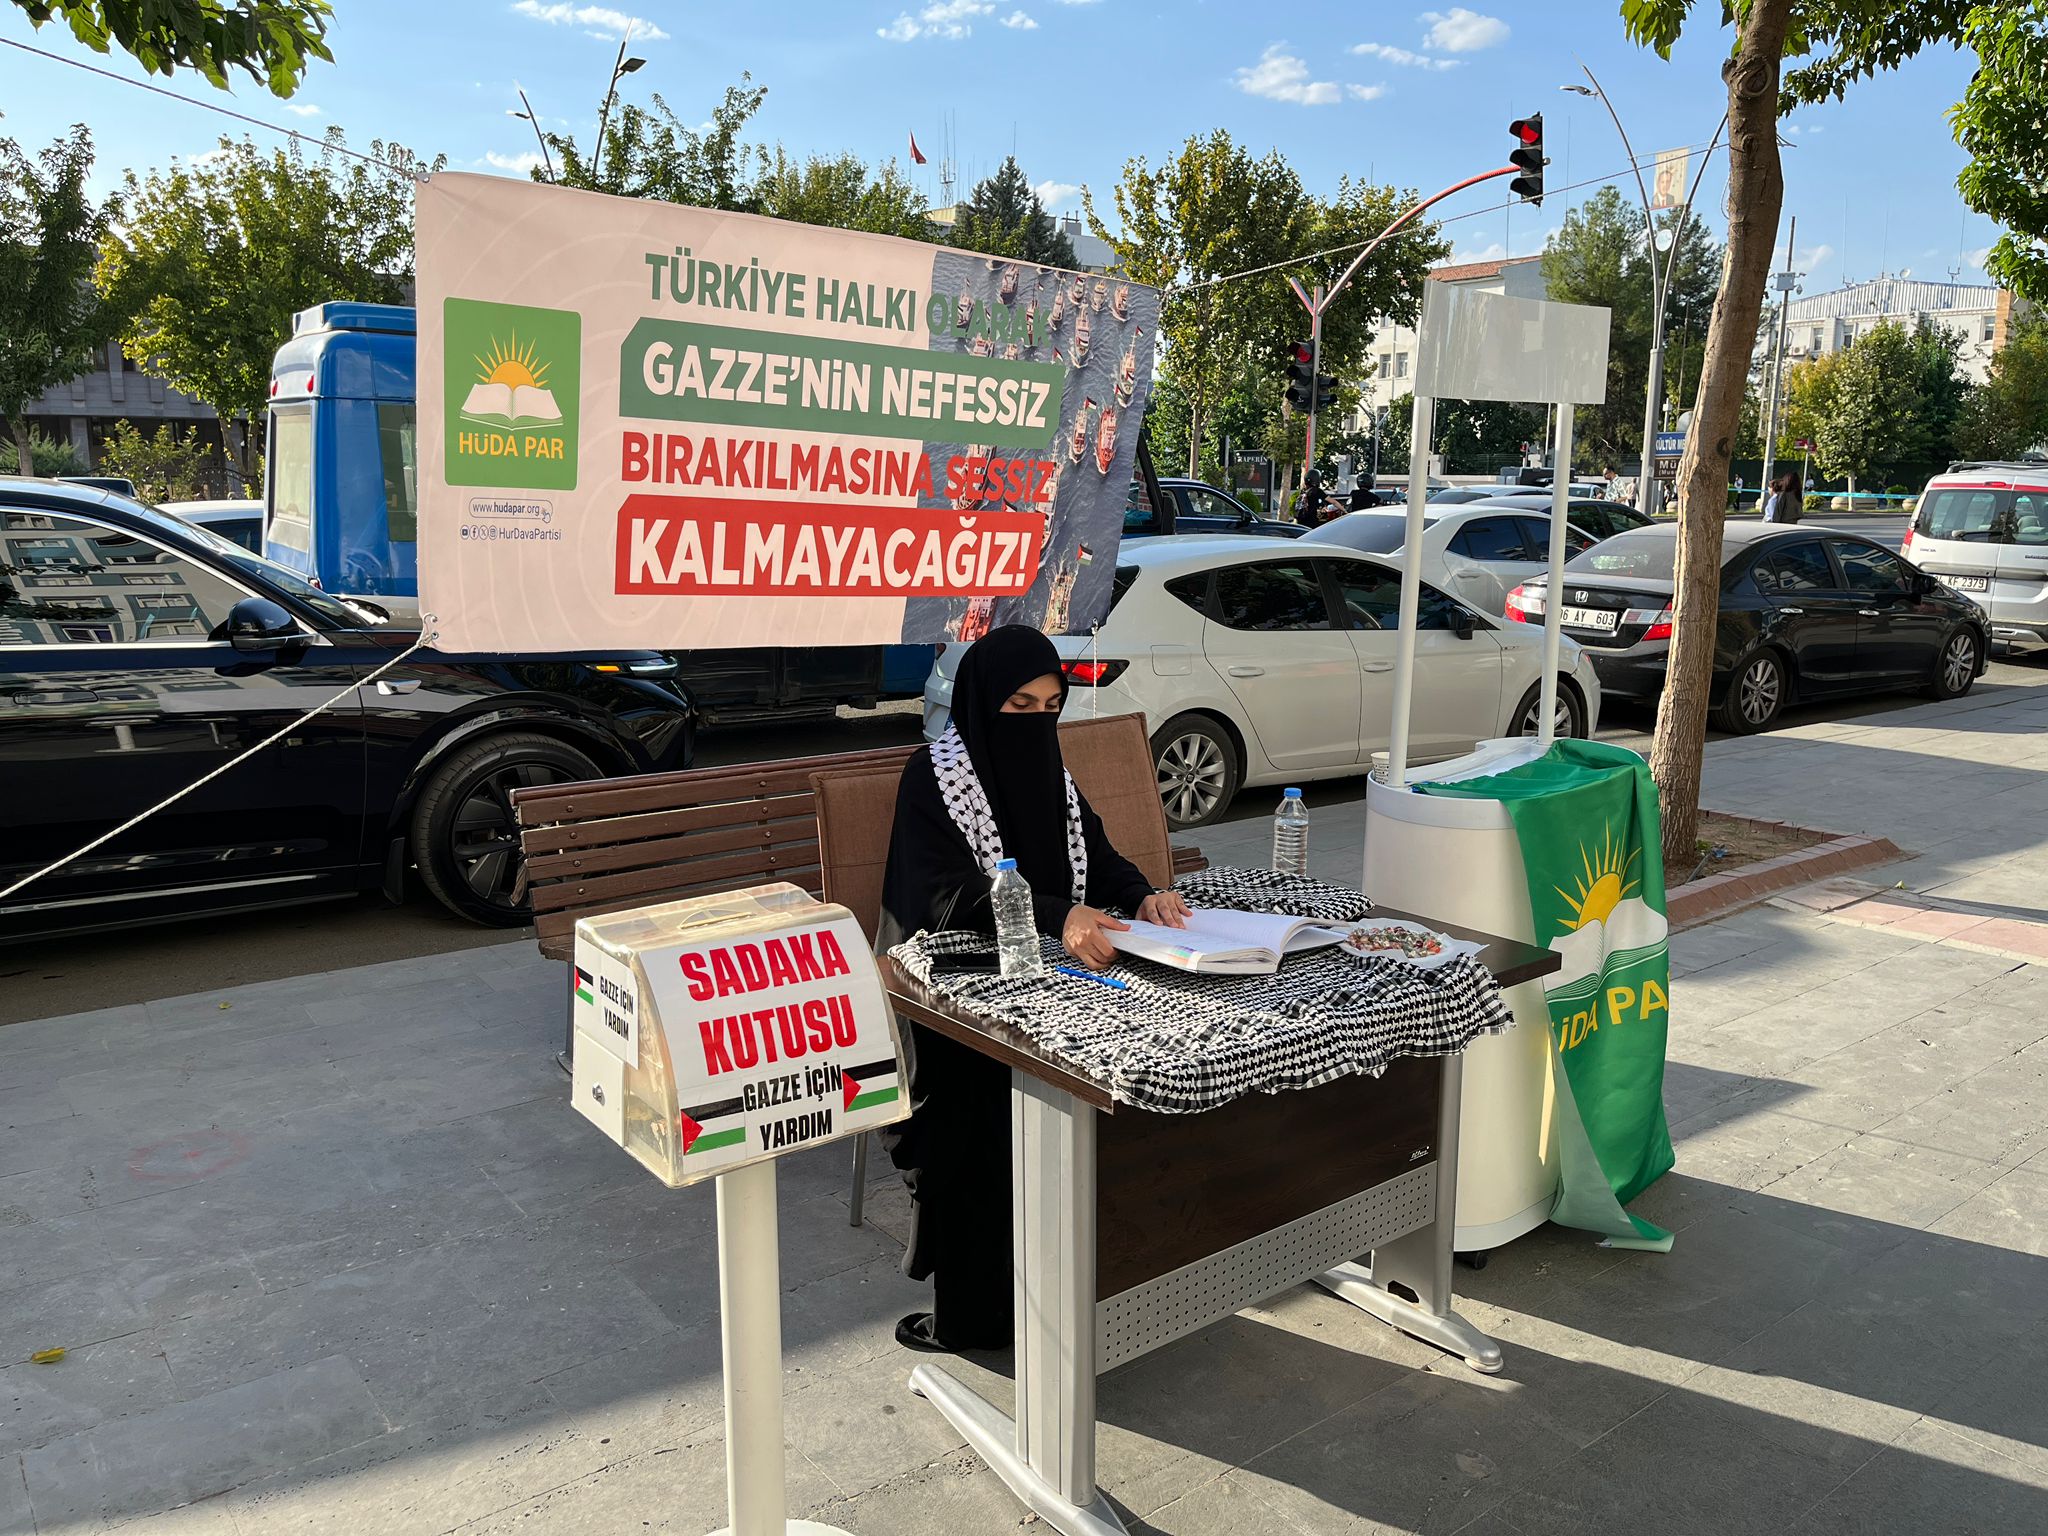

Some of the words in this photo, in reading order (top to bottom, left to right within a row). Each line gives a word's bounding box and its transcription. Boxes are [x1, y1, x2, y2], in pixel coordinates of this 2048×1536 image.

[645, 246, 806, 318] TÜRKİYE
[816, 276, 917, 332] HALKI
[926, 293, 1051, 347] OLARAK
[460, 432, 519, 456] HÜDA
[525, 436, 564, 459] PAR
[1660, 460, 1677, 469] Mü
[622, 432, 934, 499] BIRAKILMASINA
[472, 502, 540, 516] www.hudapar.org
[499, 527, 562, 540] HurDavaPartisi
[629, 515, 1032, 588] KALMAYACAĞIZ!
[1961, 577, 1985, 588] 2379
[1574, 610, 1587, 623] AY
[1596, 613, 1615, 626] 603
[679, 930, 851, 1002] SADAKA
[600, 975, 619, 1005] GAZZE
[1606, 970, 1670, 1025] PA
[604, 1006, 629, 1041] YARDIM
[698, 994, 858, 1077] KUTUSU
[743, 1074, 801, 1112] GAZZE
[805, 1062, 843, 1102] İÇİN
[760, 1109, 832, 1151] YARDIM
